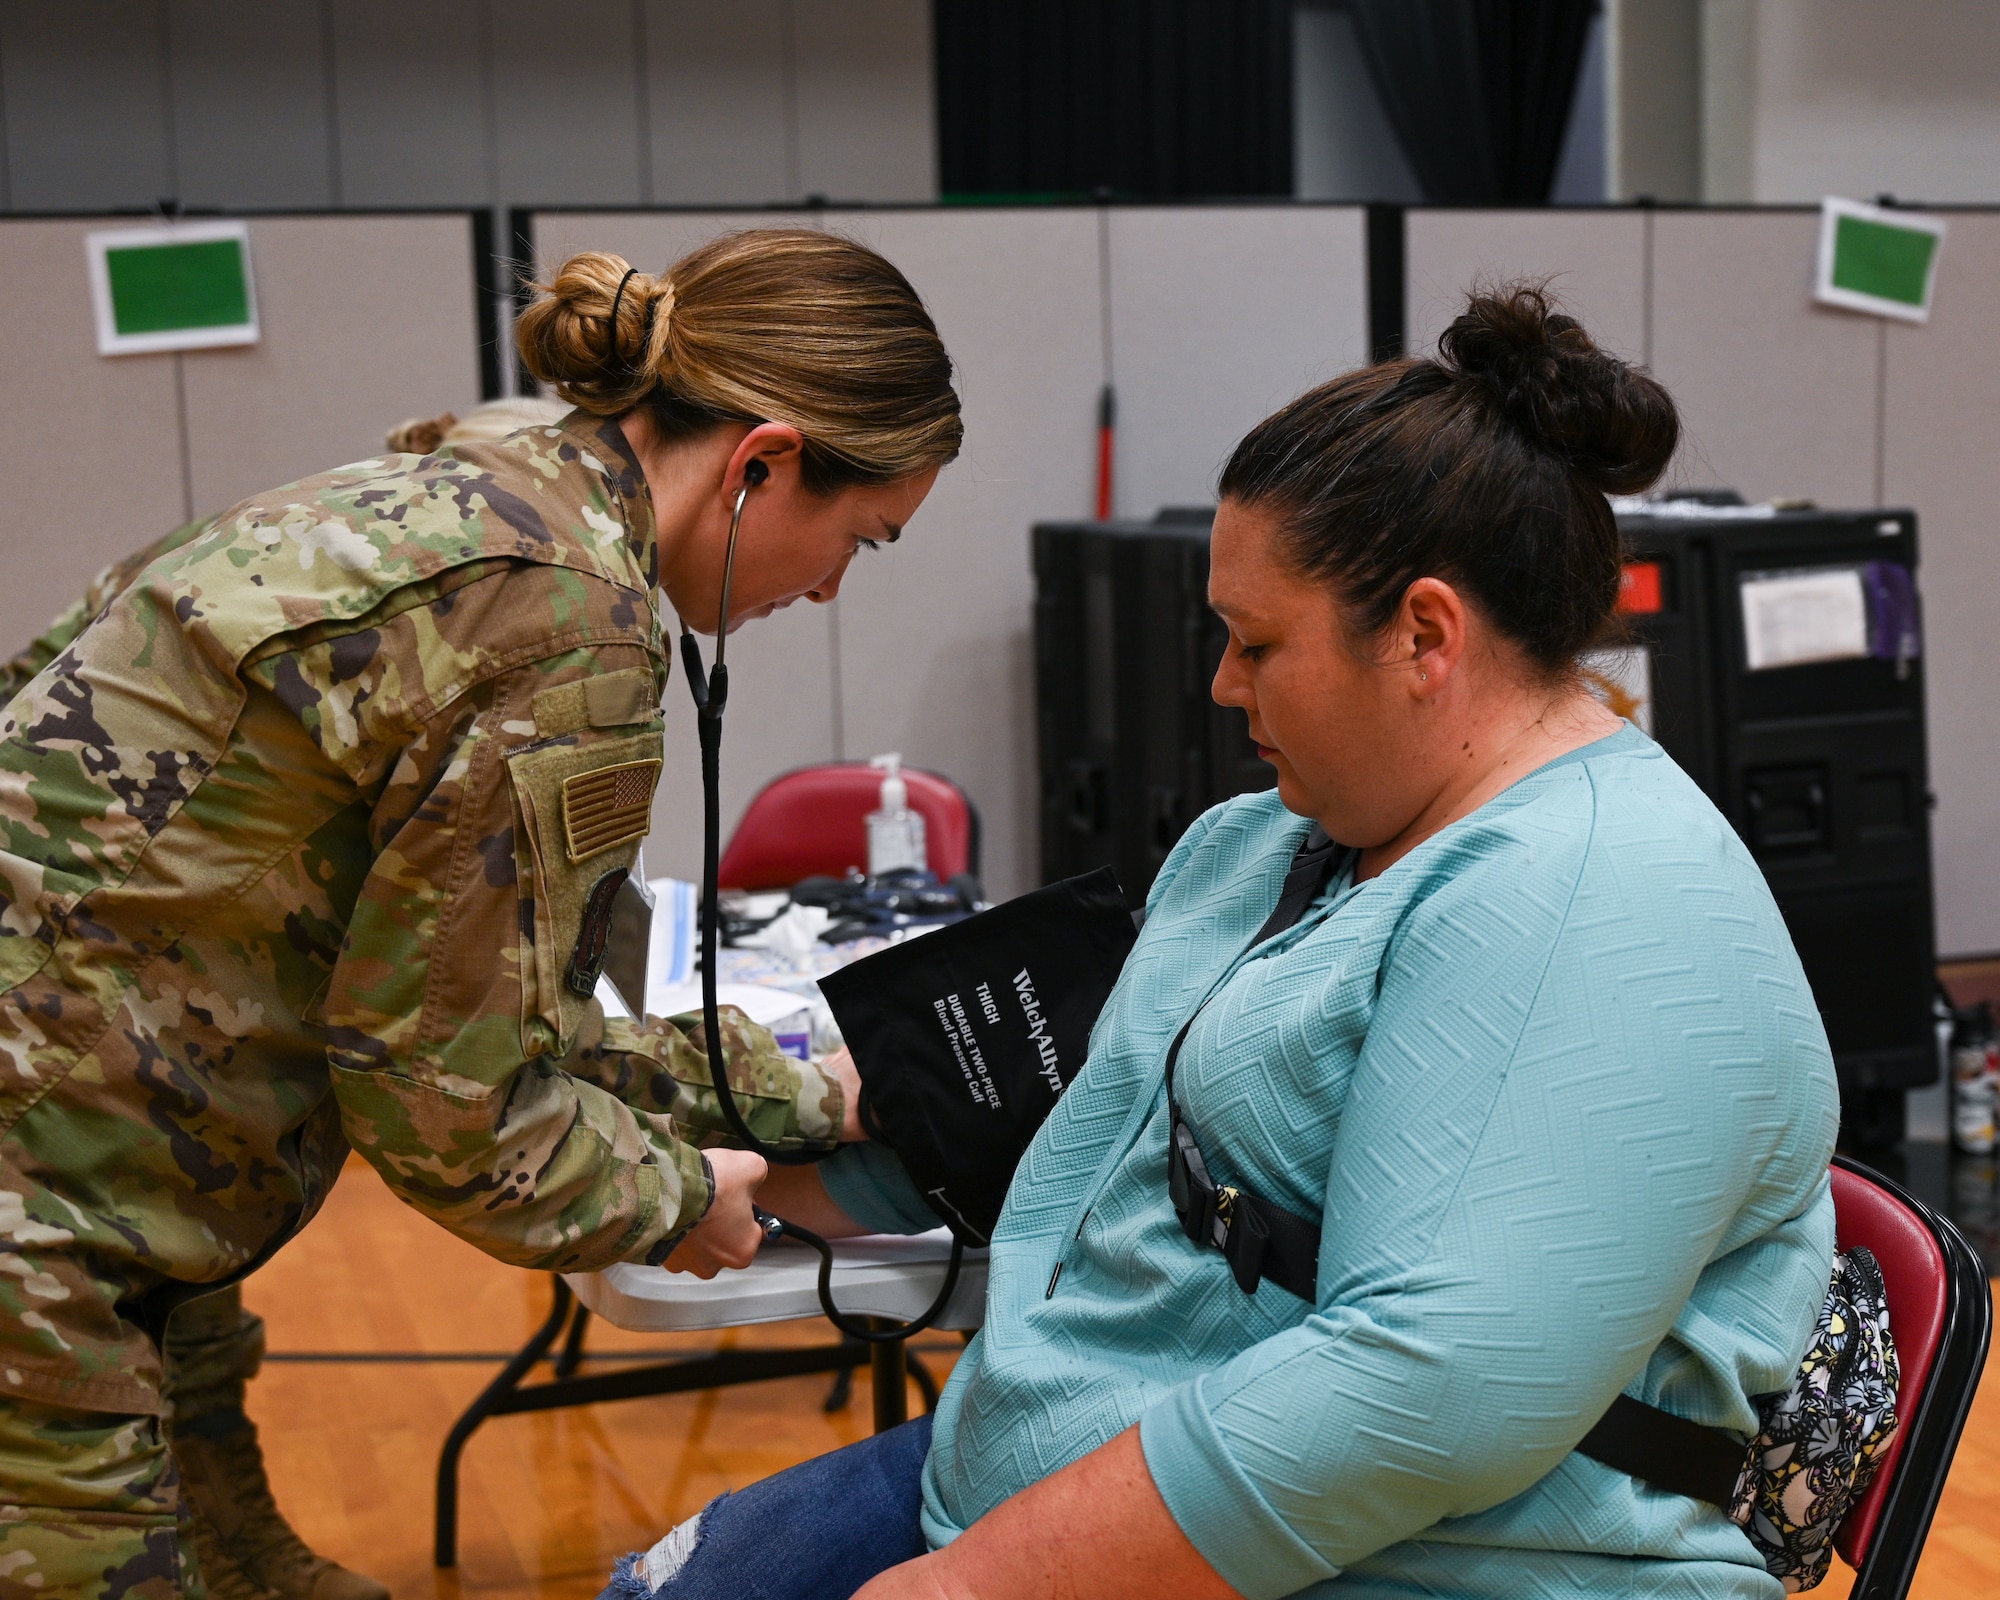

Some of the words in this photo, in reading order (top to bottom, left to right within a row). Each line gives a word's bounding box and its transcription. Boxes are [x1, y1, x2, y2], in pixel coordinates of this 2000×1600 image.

[934, 999, 955, 1032] Blood
[948, 1032, 974, 1080] Pressure
[968, 1080, 985, 1103] Cuff
[947, 993, 976, 1047] DURABLE
[969, 1046, 1002, 1110] TWO-PIECE
[975, 982, 1001, 1025] THIGH
